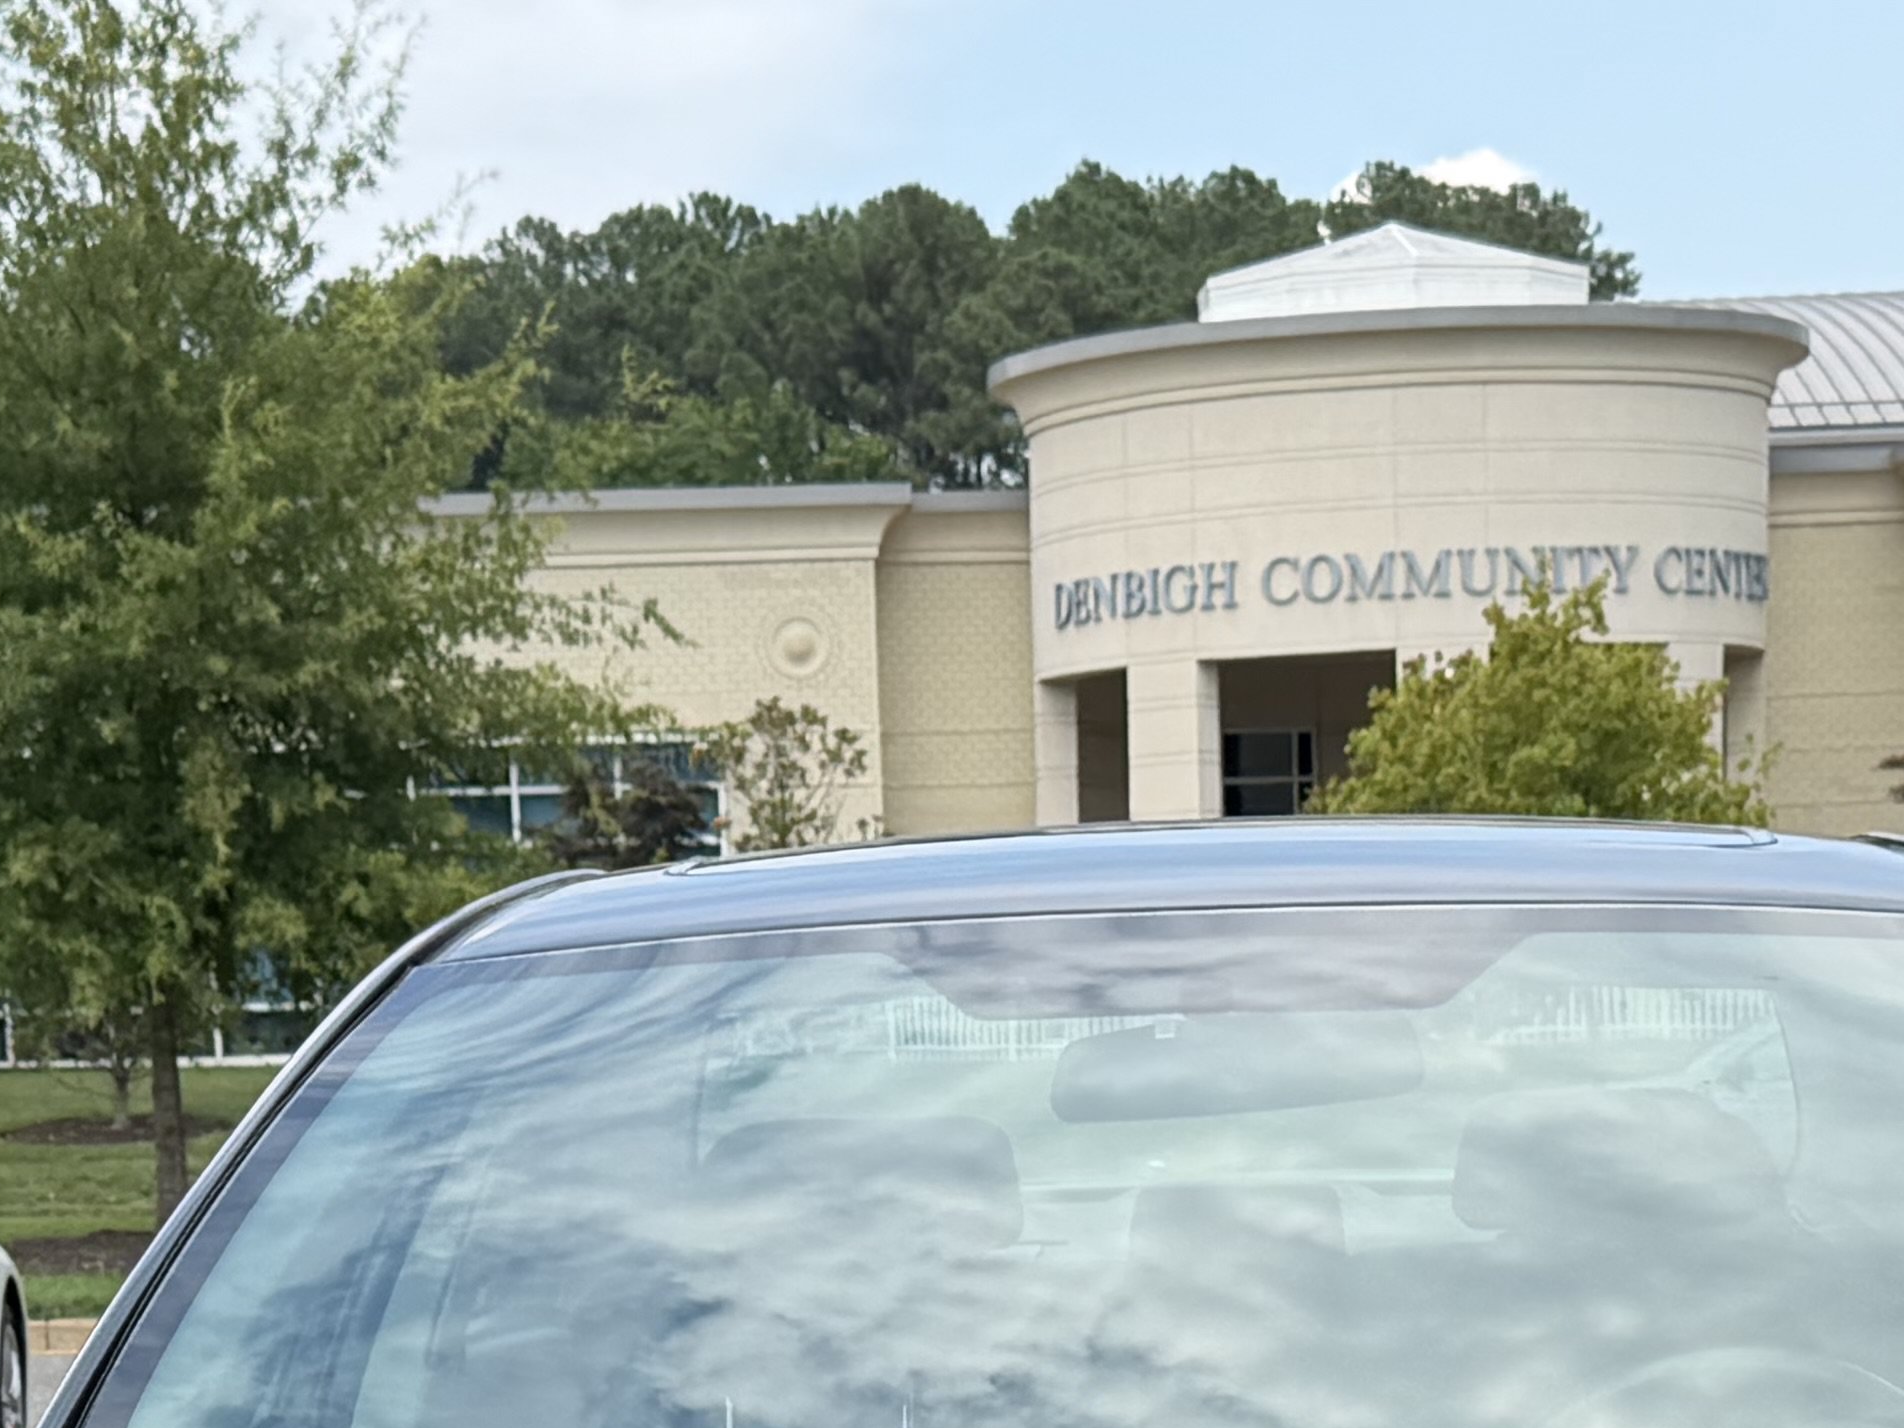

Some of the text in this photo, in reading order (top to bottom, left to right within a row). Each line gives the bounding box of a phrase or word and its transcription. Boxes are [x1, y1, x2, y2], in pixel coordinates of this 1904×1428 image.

[1054, 544, 1770, 632] DENBIGH COMMUNITY CENTE
